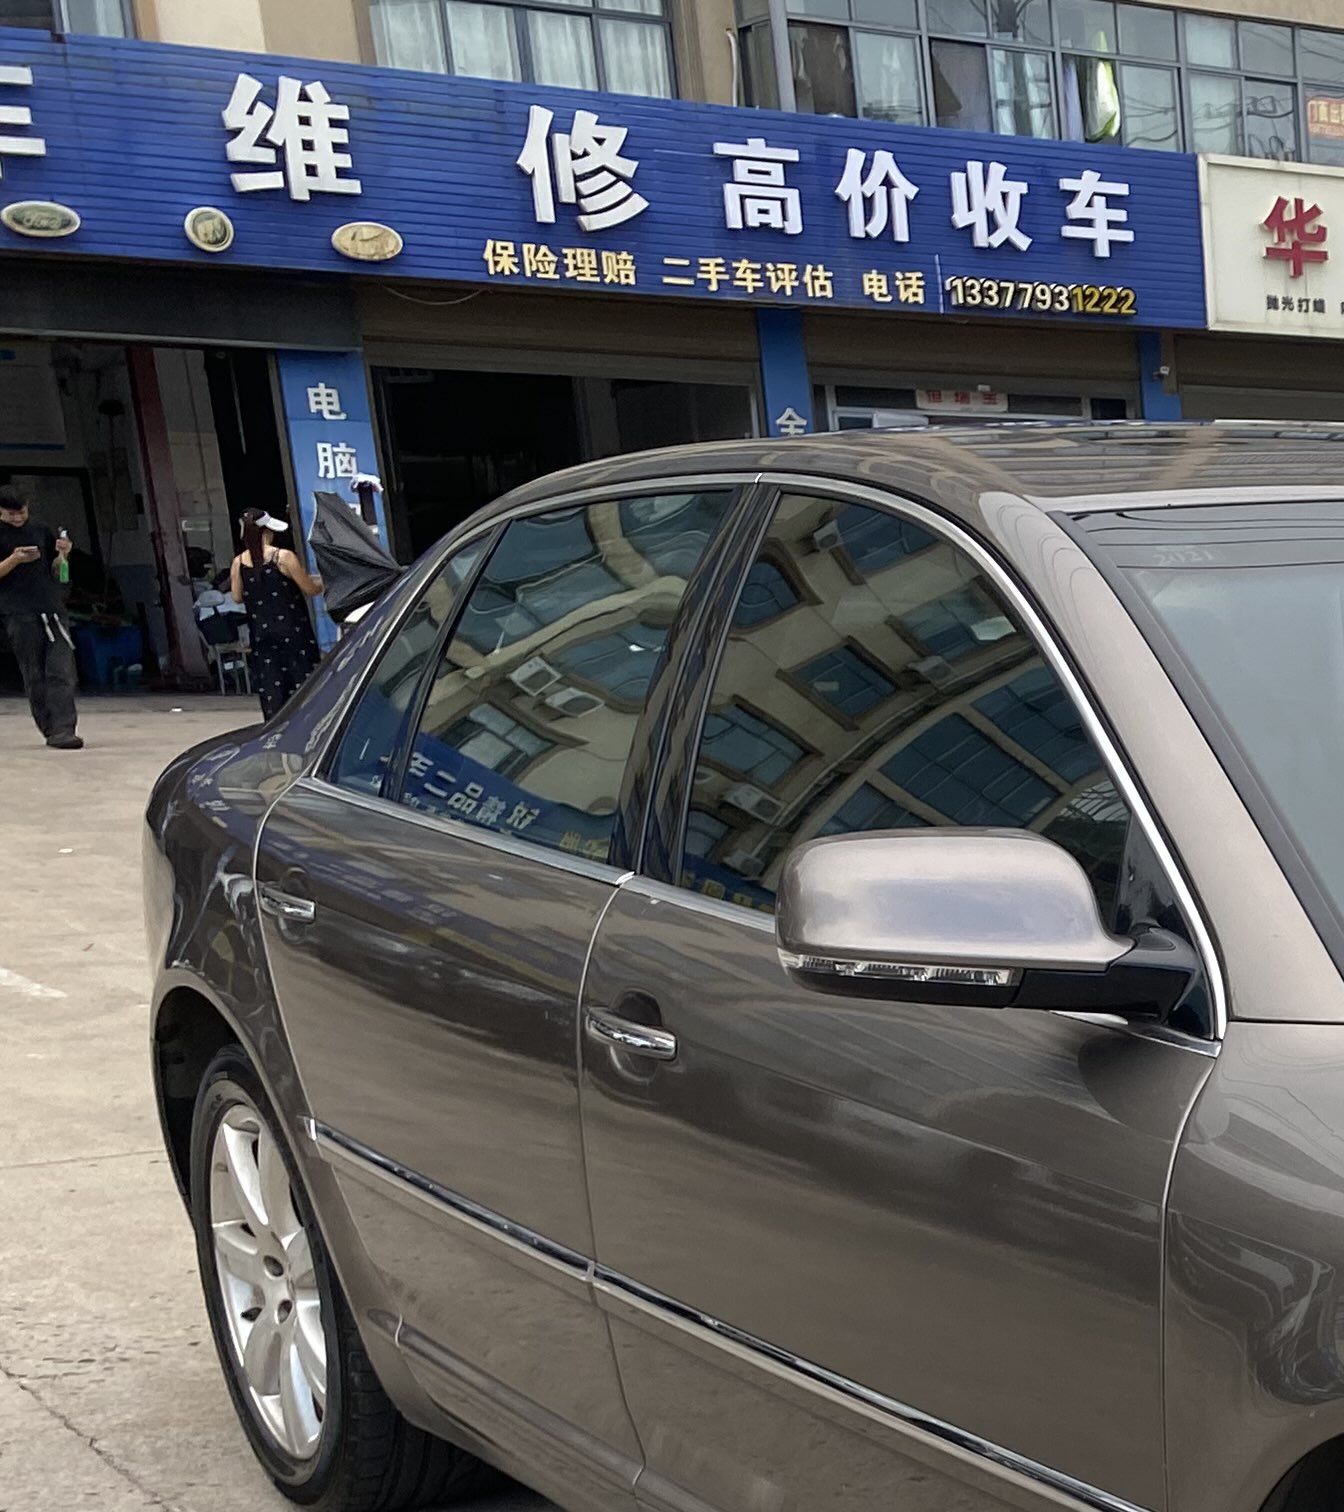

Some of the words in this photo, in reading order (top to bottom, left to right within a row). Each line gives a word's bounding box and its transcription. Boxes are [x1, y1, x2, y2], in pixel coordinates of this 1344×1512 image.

[713, 138, 1135, 258] 高价收车
[483, 239, 637, 286] 保险理赔
[662, 257, 834, 299] 二手车评估
[862, 269, 926, 304] 电话
[945, 276, 1137, 315] 13377931222
